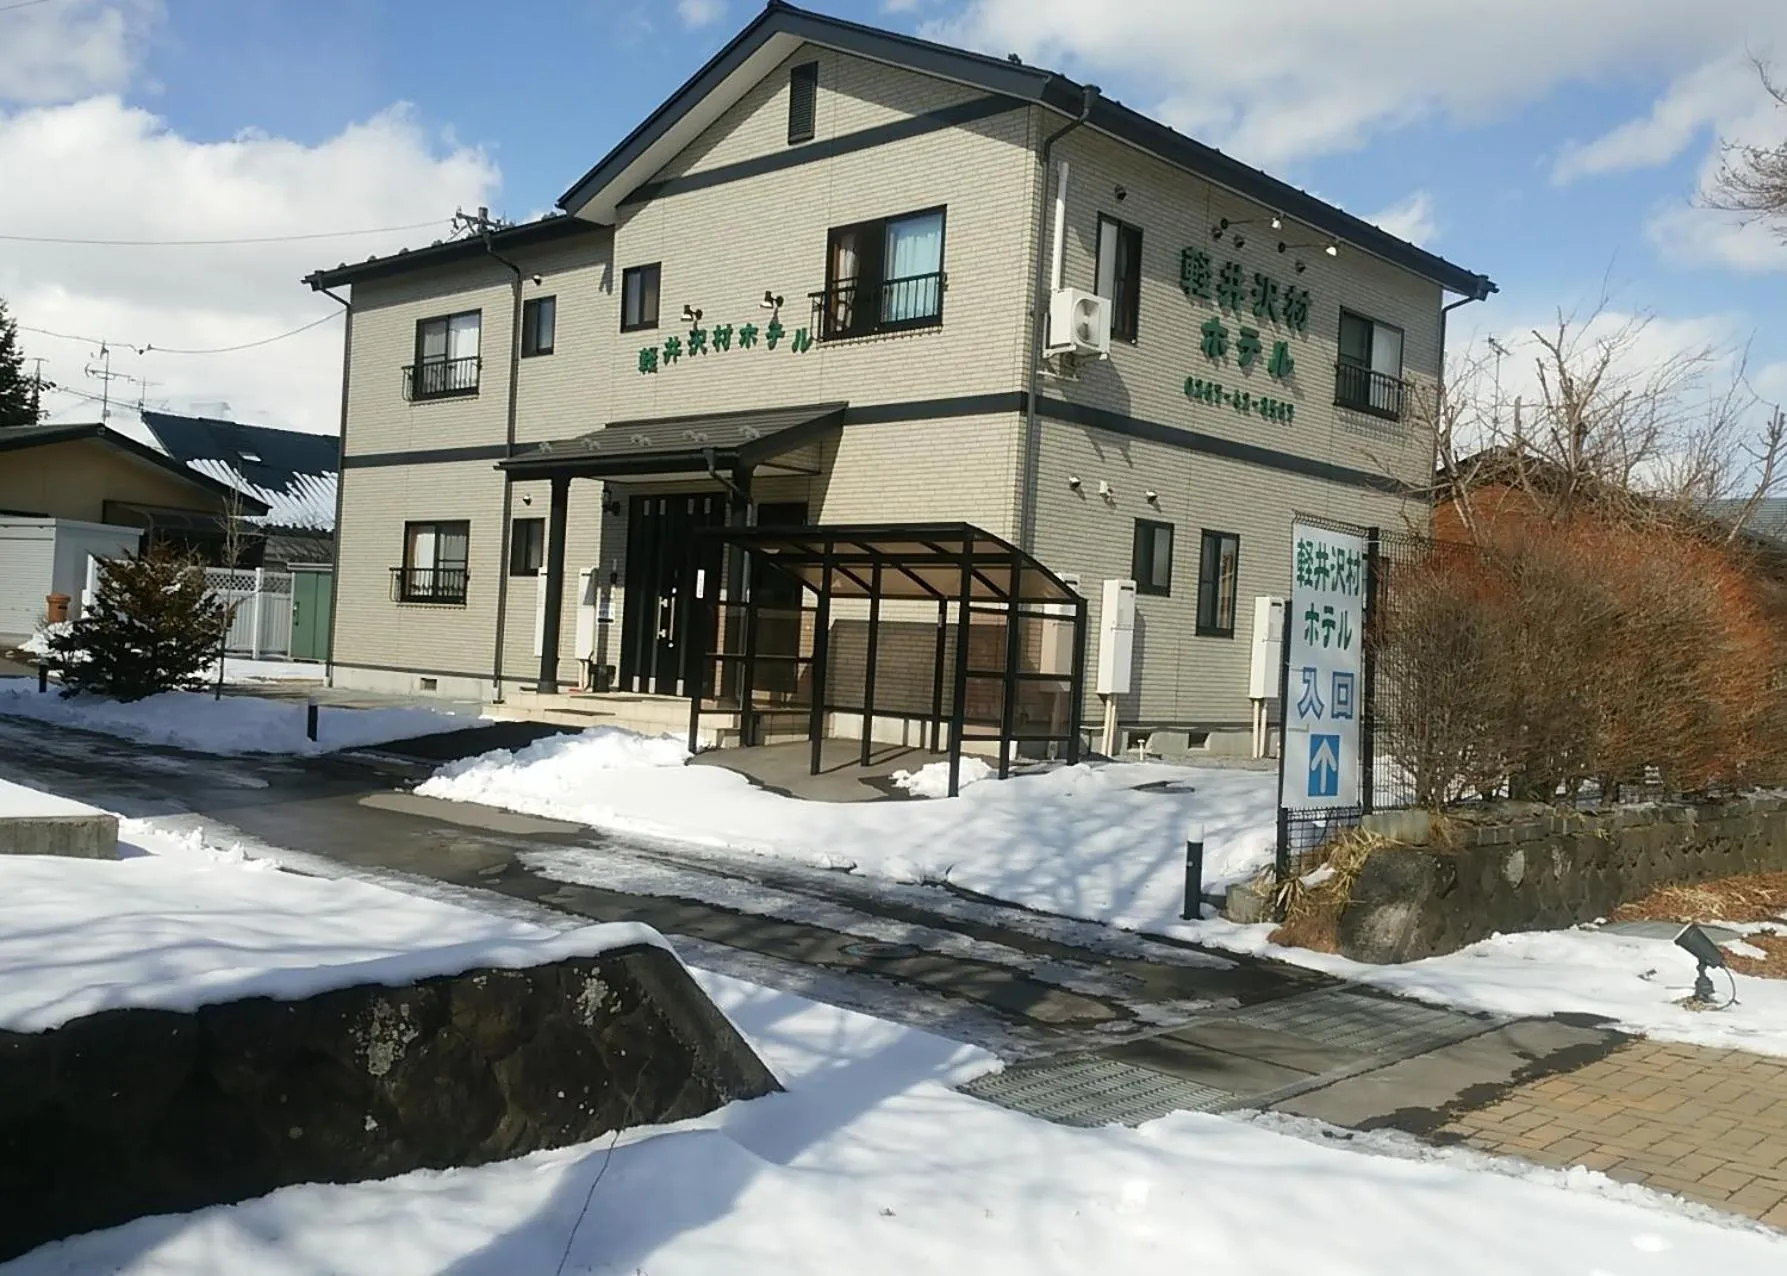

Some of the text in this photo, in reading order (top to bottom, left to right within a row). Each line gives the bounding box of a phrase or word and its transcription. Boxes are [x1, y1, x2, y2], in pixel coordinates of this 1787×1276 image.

[1201, 316, 1295, 378] ホテル
[1297, 537, 1361, 596] 軽井沢村
[1304, 602, 1353, 651] ホテル
[1297, 667, 1355, 720] 入口
